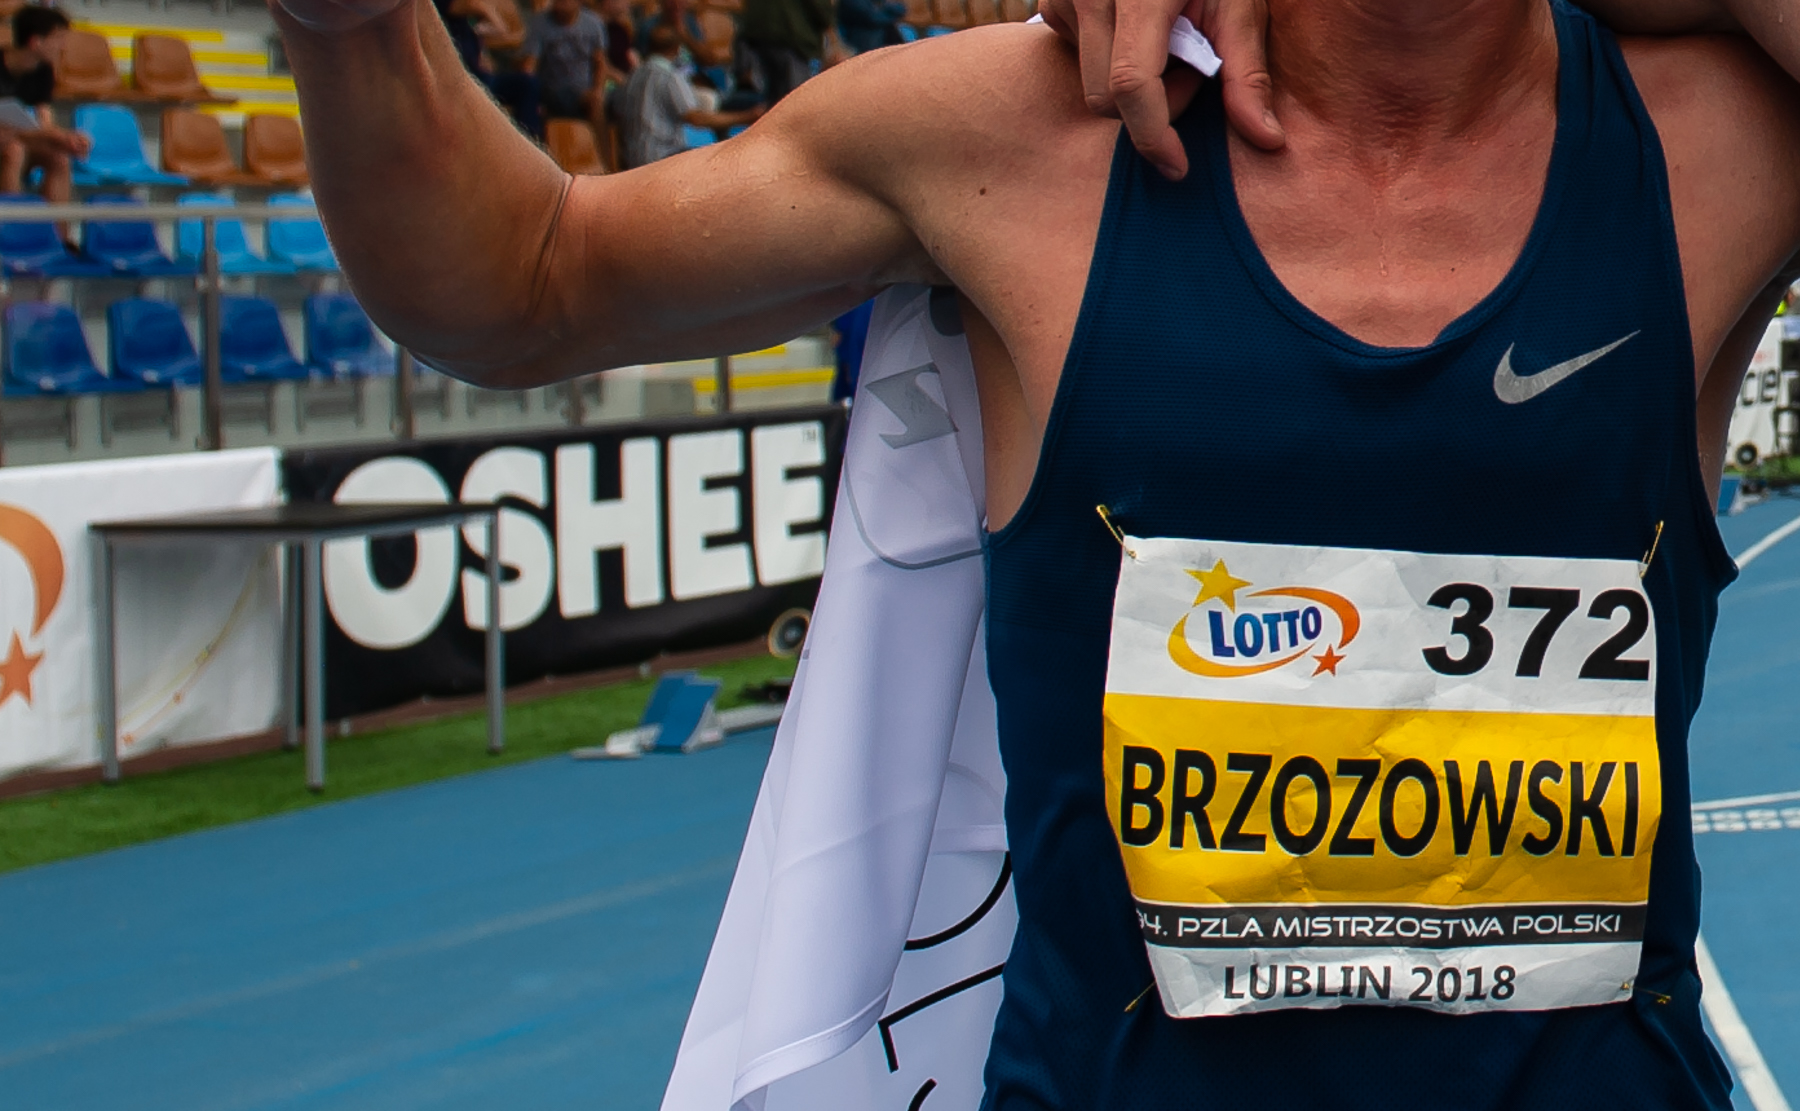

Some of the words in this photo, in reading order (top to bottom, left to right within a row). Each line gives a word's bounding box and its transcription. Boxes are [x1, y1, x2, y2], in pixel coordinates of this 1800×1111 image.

[322, 420, 827, 649] OSHEE
[1209, 605, 1323, 658] LOTTO
[1421, 583, 1651, 682] 372
[1120, 745, 1639, 858] BRZOZOWSKI
[1177, 917, 1264, 938] PZLA
[1272, 916, 1504, 939] MISTRZOSTWA
[1512, 914, 1622, 935] POLSKI
[1223, 964, 1391, 1000] LUBLIN
[1408, 965, 1516, 1002] 2018
